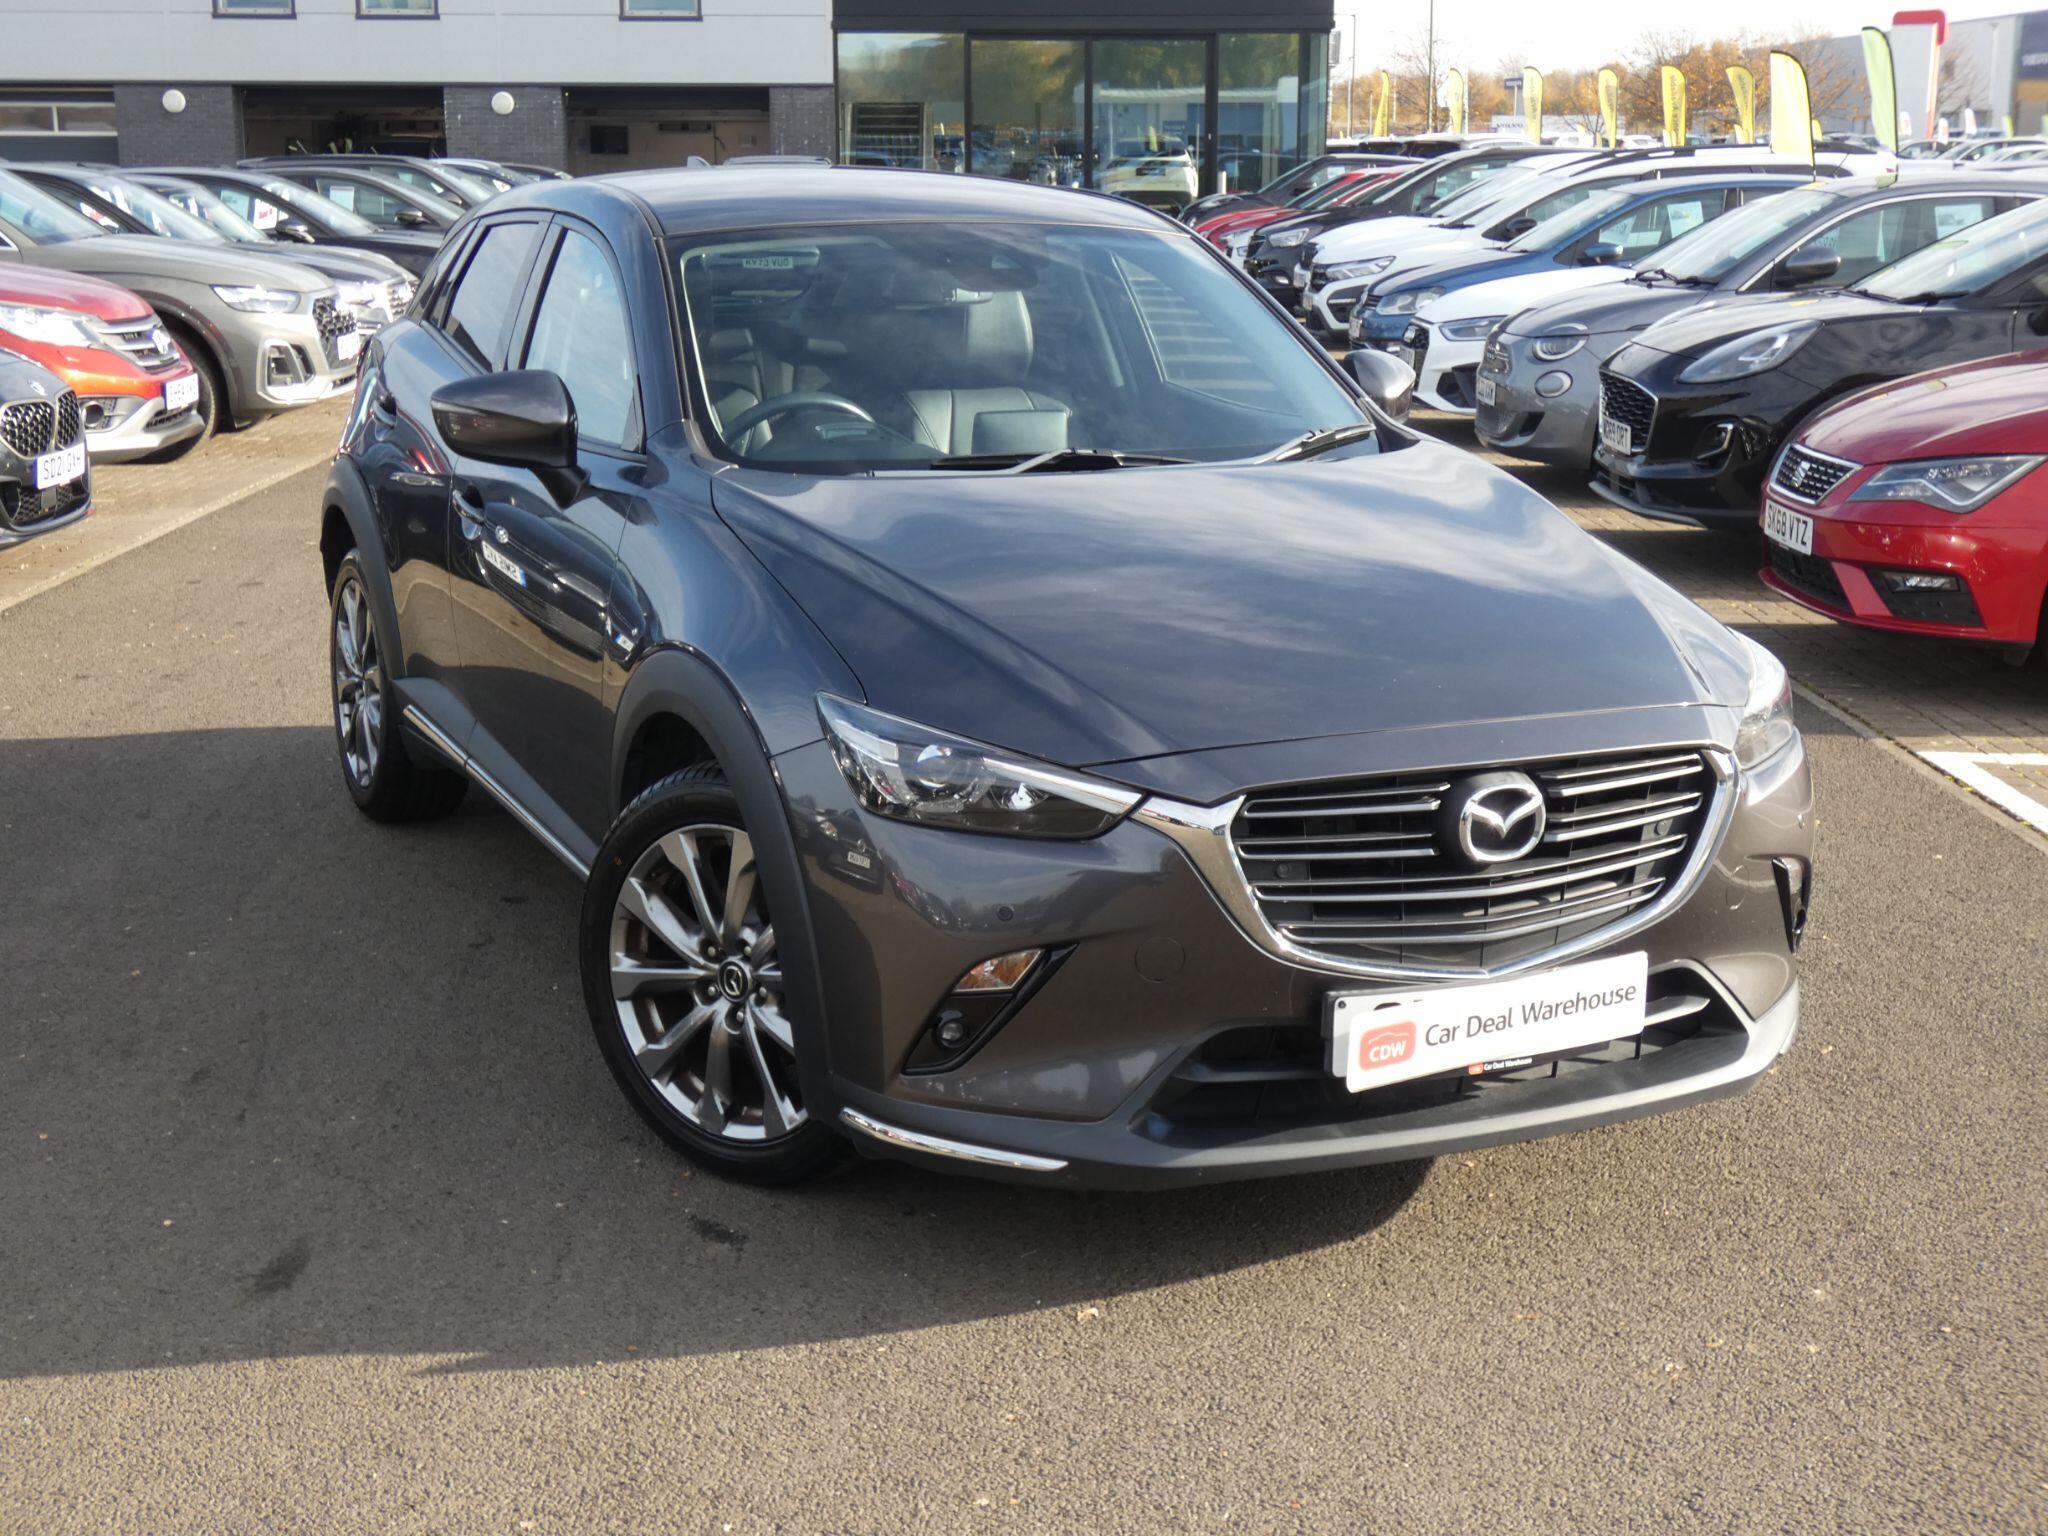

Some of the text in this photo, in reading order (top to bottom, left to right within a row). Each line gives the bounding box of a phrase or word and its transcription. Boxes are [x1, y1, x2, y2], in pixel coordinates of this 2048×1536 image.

[43, 456, 65, 480] SD21
[1767, 504, 1808, 546] SK68 VTZ
[1425, 985, 1637, 1047] Car Deal Warehouse
[1368, 1041, 1408, 1063] CDW
